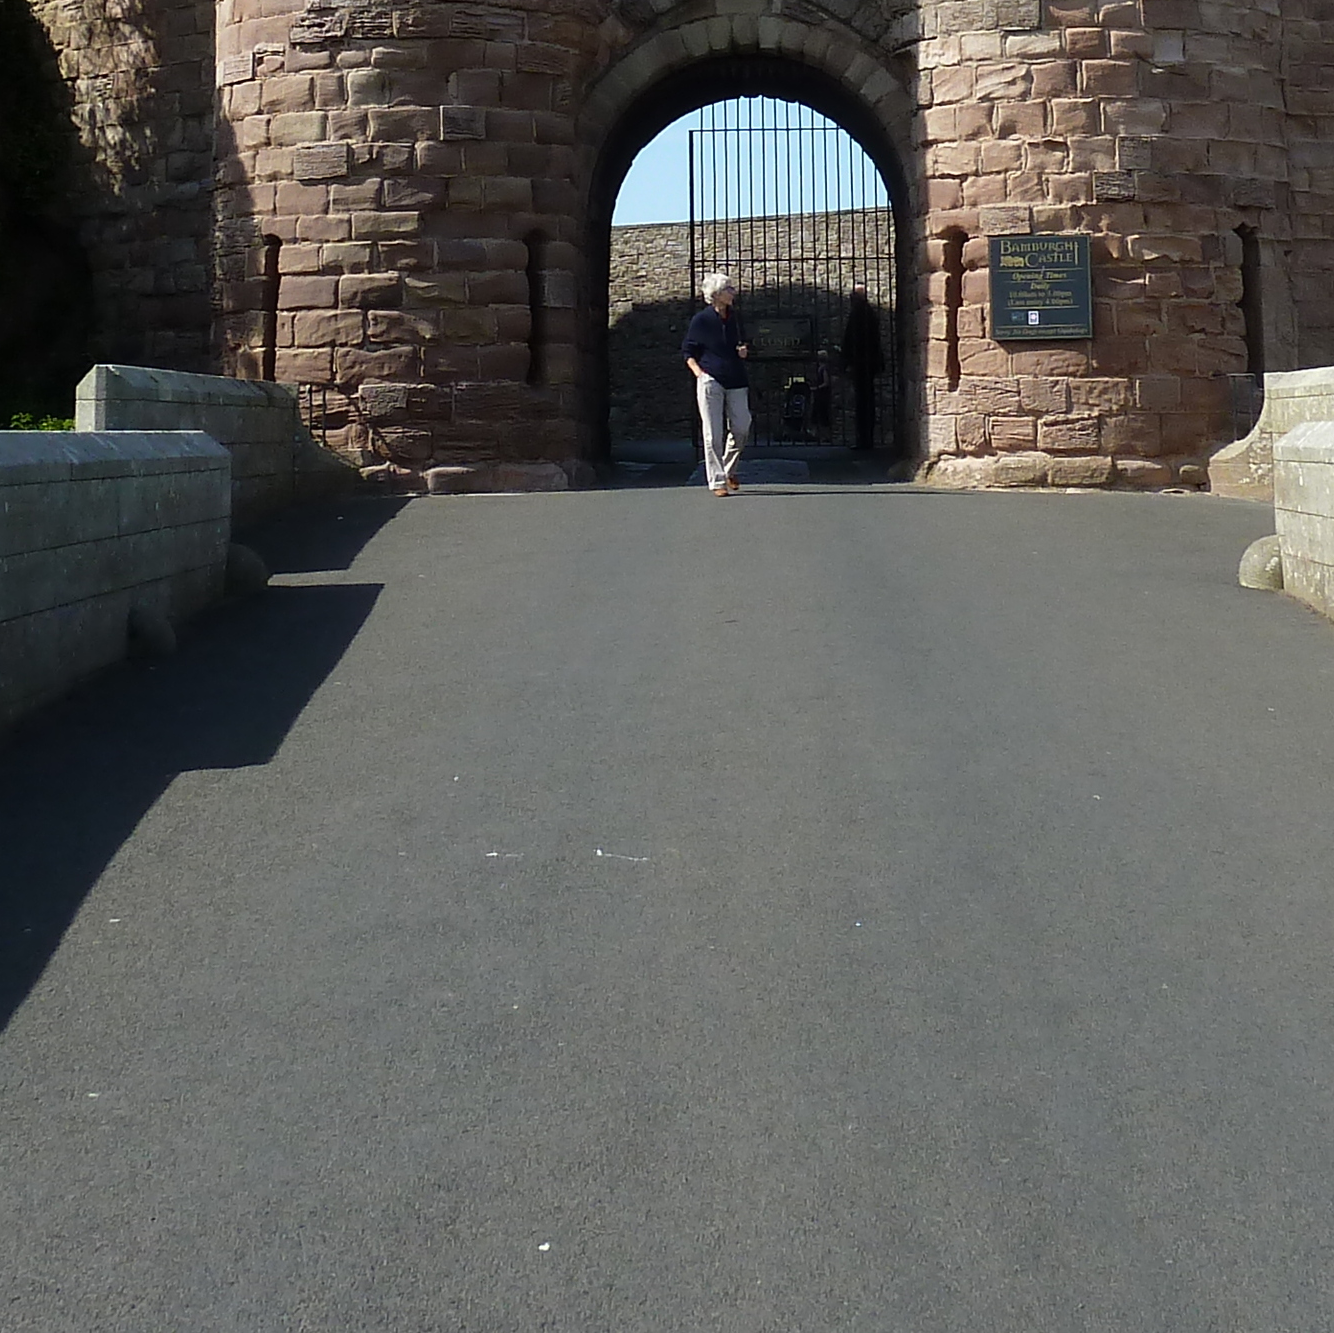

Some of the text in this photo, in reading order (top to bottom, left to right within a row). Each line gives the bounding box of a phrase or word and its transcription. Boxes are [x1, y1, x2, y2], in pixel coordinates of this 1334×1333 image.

[1000, 240, 1073, 254] BAMBURGH
[1025, 252, 1073, 268] CASTLE
[1012, 271, 1067, 281] Opening Times
[1030, 281, 1050, 290] Daily
